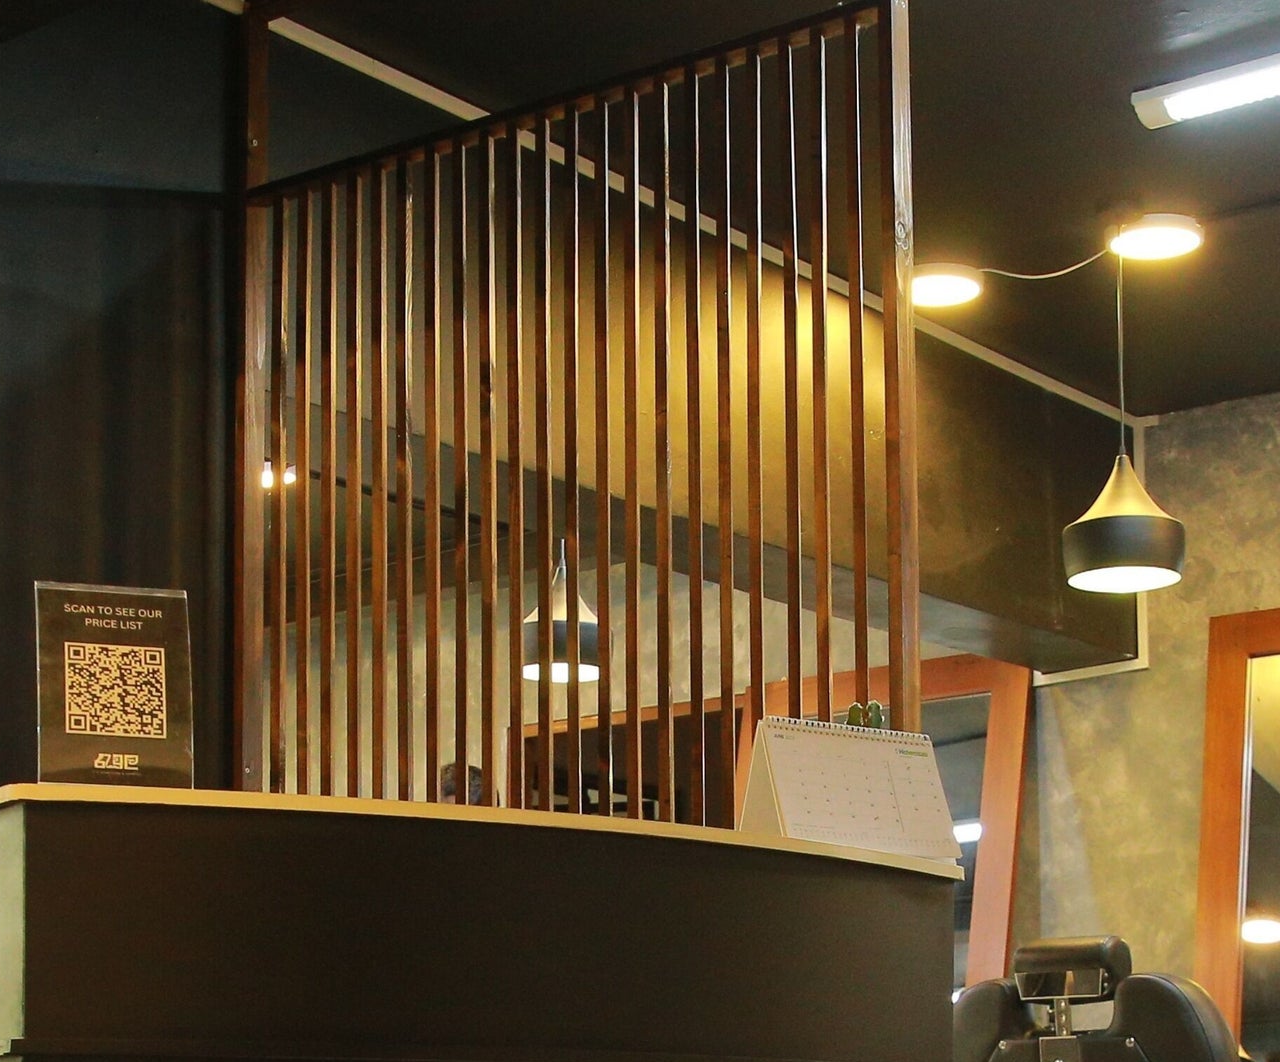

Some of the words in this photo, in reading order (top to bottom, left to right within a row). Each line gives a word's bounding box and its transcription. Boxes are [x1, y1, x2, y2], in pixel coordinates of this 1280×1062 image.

[63, 603, 95, 614] SCAN
[97, 606, 113, 615] TO
[115, 607, 136, 617] SEE
[138, 609, 163, 618] OUR
[84, 617, 118, 629] PRICE
[120, 620, 143, 630] LIST
